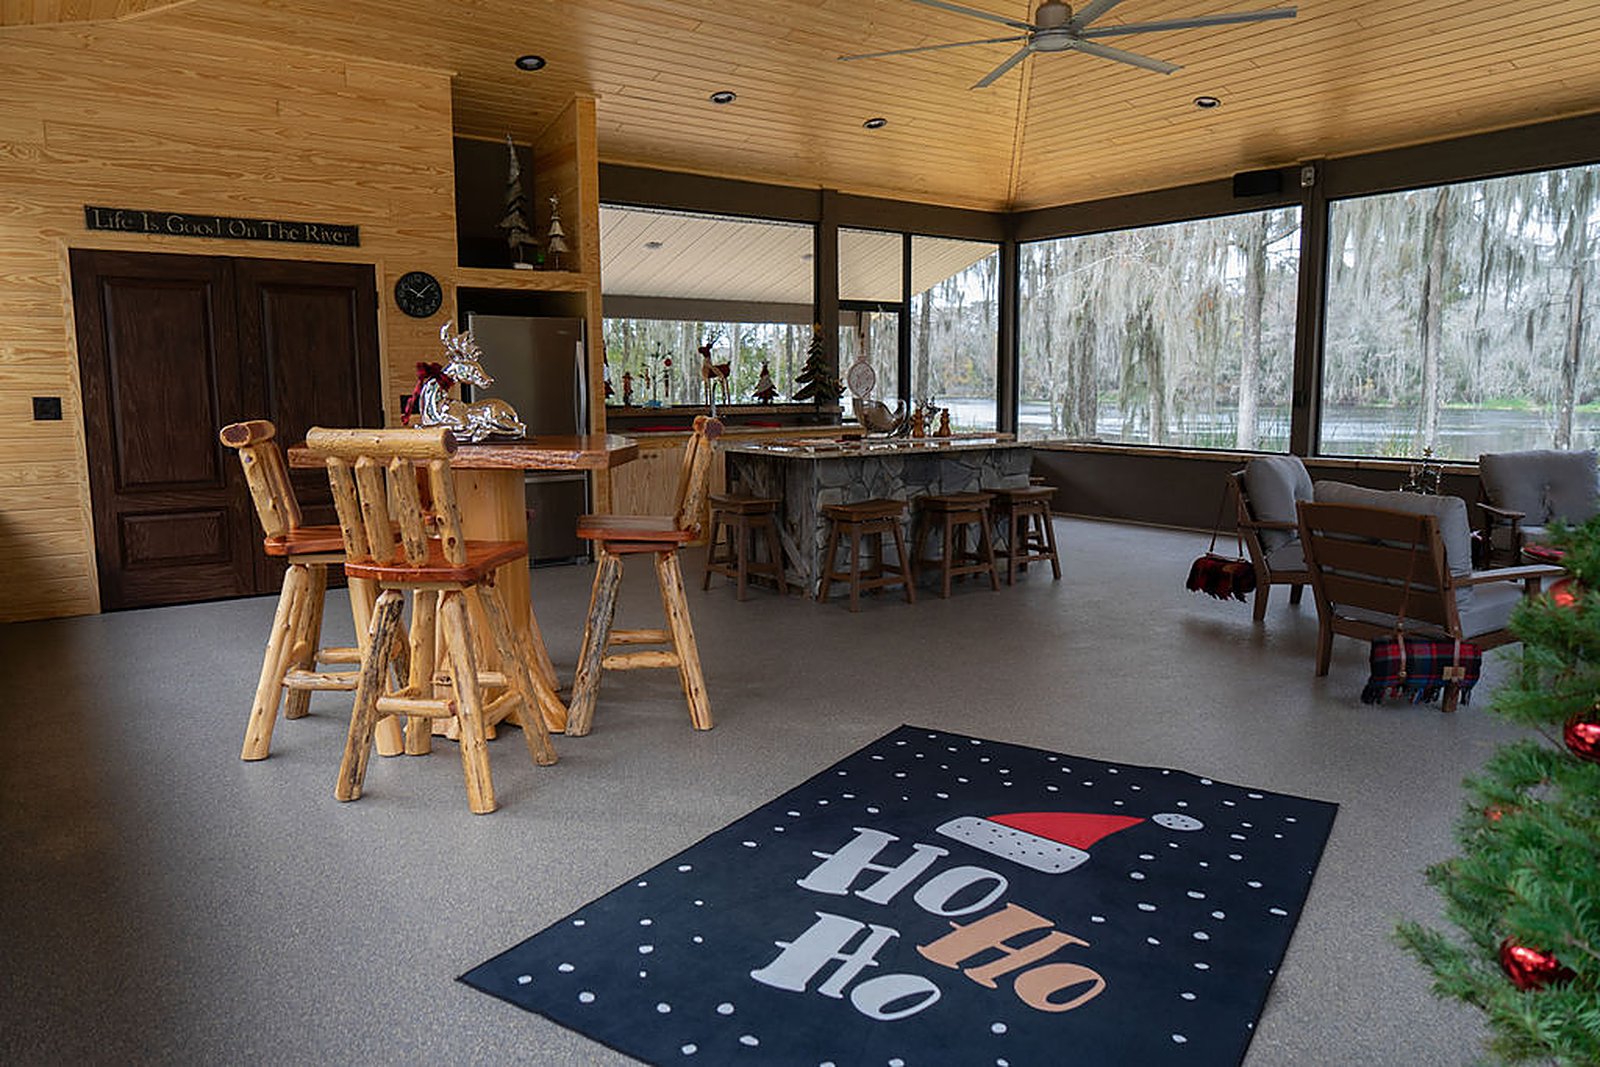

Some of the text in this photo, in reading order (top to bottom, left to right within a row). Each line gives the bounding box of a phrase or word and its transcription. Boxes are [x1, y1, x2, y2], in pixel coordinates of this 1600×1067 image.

[93, 208, 351, 244] Life Is Good On The River
